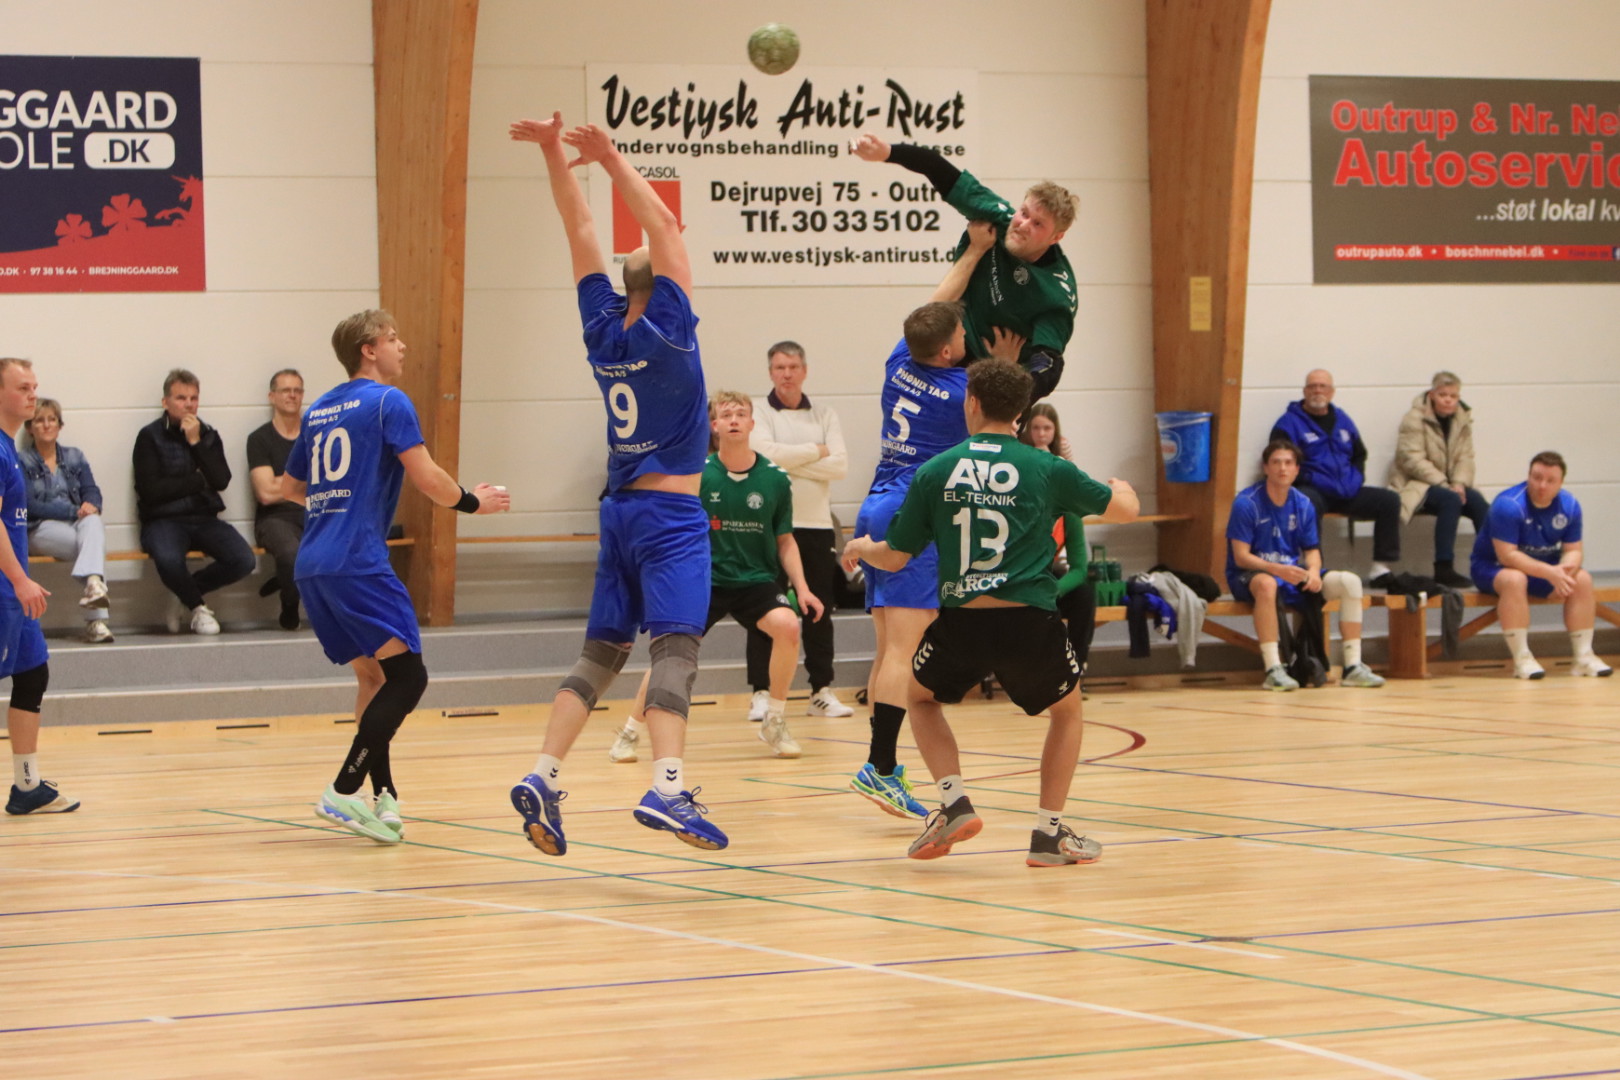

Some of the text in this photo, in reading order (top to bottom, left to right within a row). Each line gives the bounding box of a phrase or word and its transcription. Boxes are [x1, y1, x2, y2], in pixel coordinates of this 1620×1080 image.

[601, 74, 965, 140] Vestjysk Anti-Rust
[1332, 100, 1620, 141] Outrup & Nr. Ne
[102, 139, 151, 163] .DK
[611, 140, 839, 158] ndervognsbehandling
[633, 165, 680, 179] CASOL
[710, 181, 822, 207] Dejrupvej
[833, 182, 861, 202] 75
[1541, 198, 1596, 222] lokal
[1336, 246, 1424, 260] outrupauto.dk
[30, 267, 41, 276] 97
[65, 267, 78, 275] 44
[88, 266, 179, 276] BREJNINGGAARD.DK
[928, 385, 950, 400] TAG
[342, 399, 361, 411] TAG
[609, 382, 639, 439] 9
[887, 394, 921, 443] 5
[311, 427, 352, 485] 10
[943, 491, 1018, 507] EL-TEKNIK
[952, 507, 1010, 576] 13
